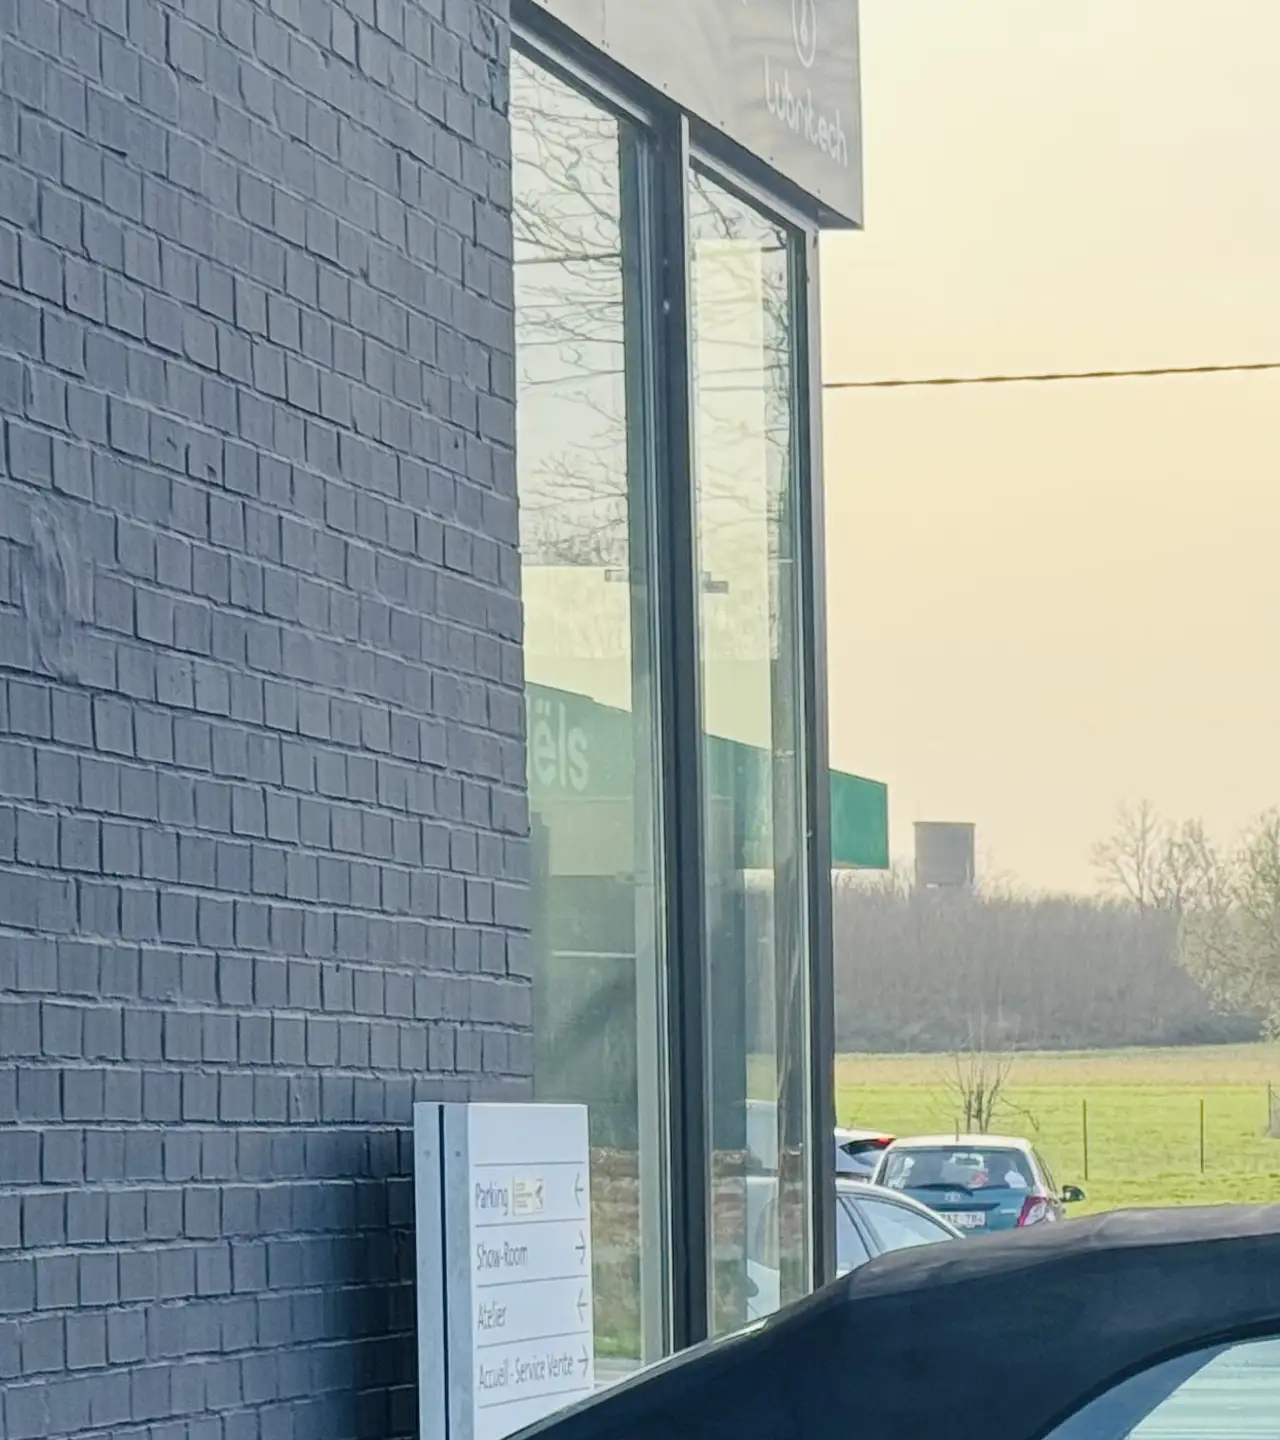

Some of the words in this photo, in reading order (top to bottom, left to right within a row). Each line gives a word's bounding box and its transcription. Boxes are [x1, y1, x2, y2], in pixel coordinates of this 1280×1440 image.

[475, 1180, 508, 1217] Parking
[477, 1241, 528, 1270] Show-Room
[478, 1300, 506, 1330] Atelier
[479, 1357, 508, 1390] Accueil
[515, 1355, 546, 1384] Service
[545, 1351, 574, 1379] Vente
